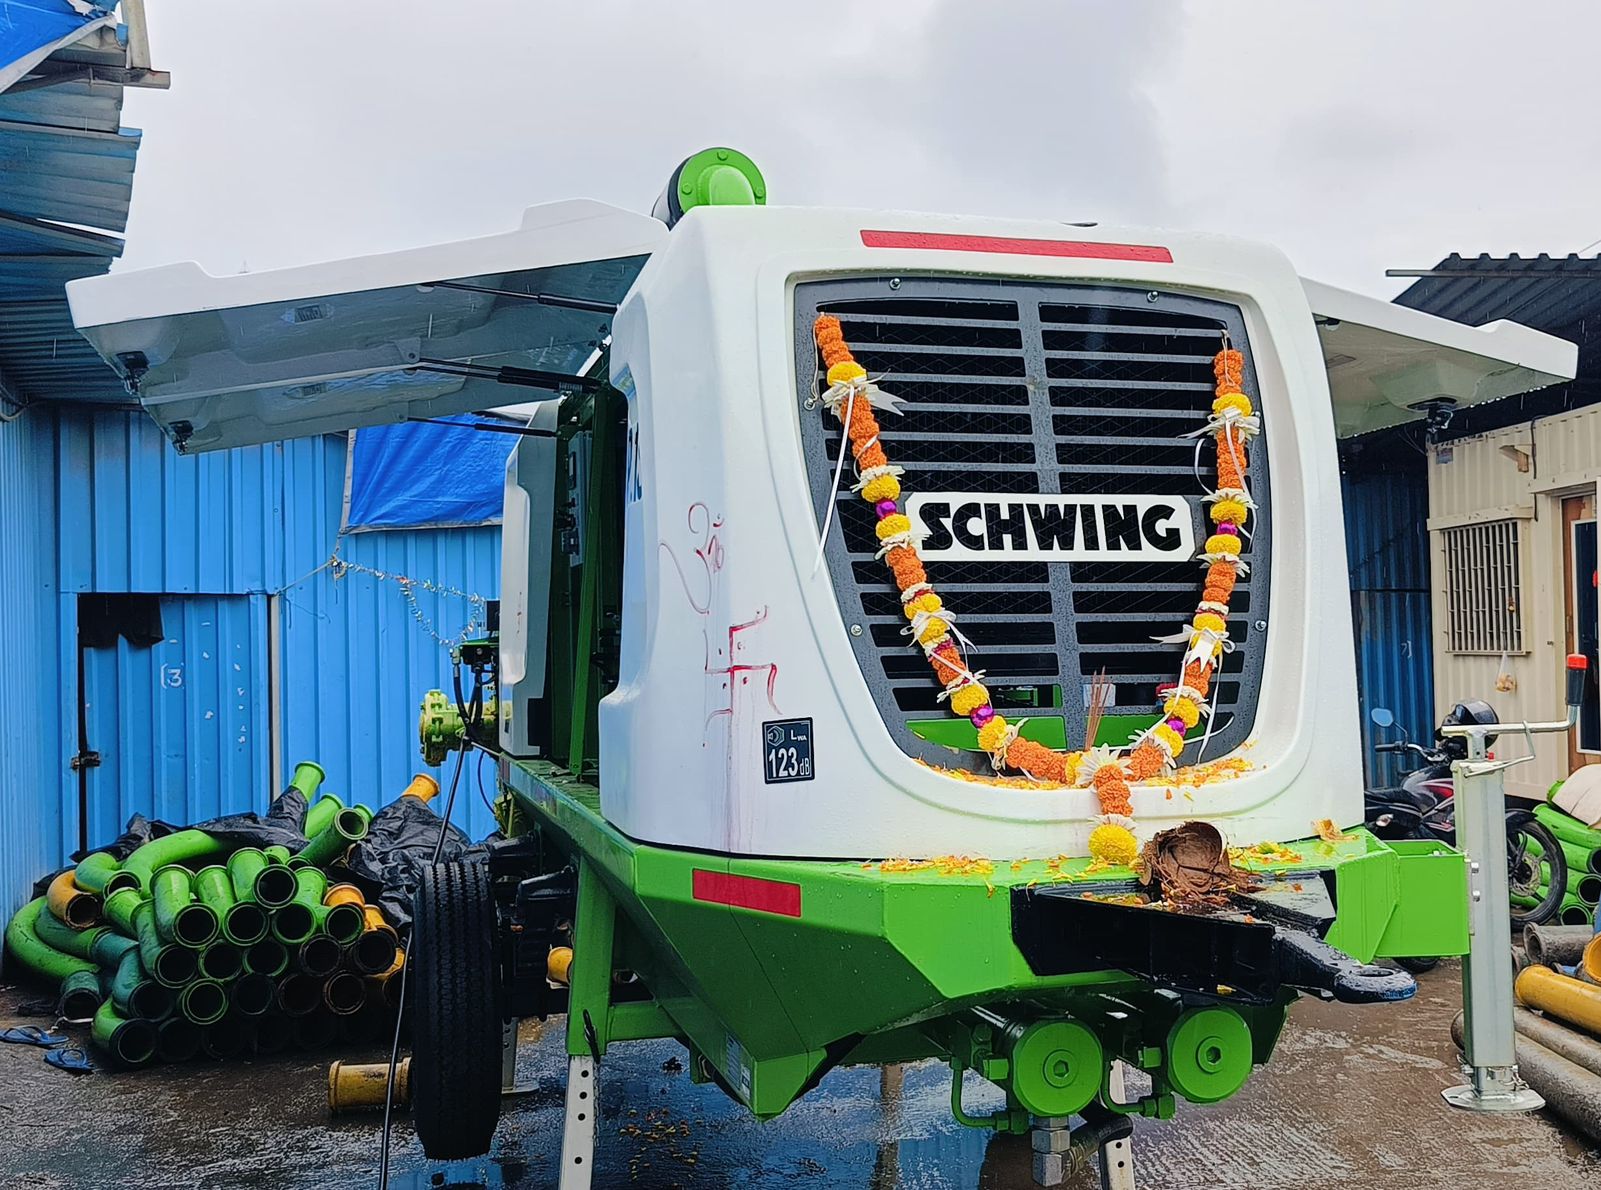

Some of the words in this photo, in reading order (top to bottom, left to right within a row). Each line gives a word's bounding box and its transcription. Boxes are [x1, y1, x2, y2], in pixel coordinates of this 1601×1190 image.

[918, 502, 1182, 551] SCHWING
[769, 747, 798, 777] 123
[799, 757, 810, 775] dB
